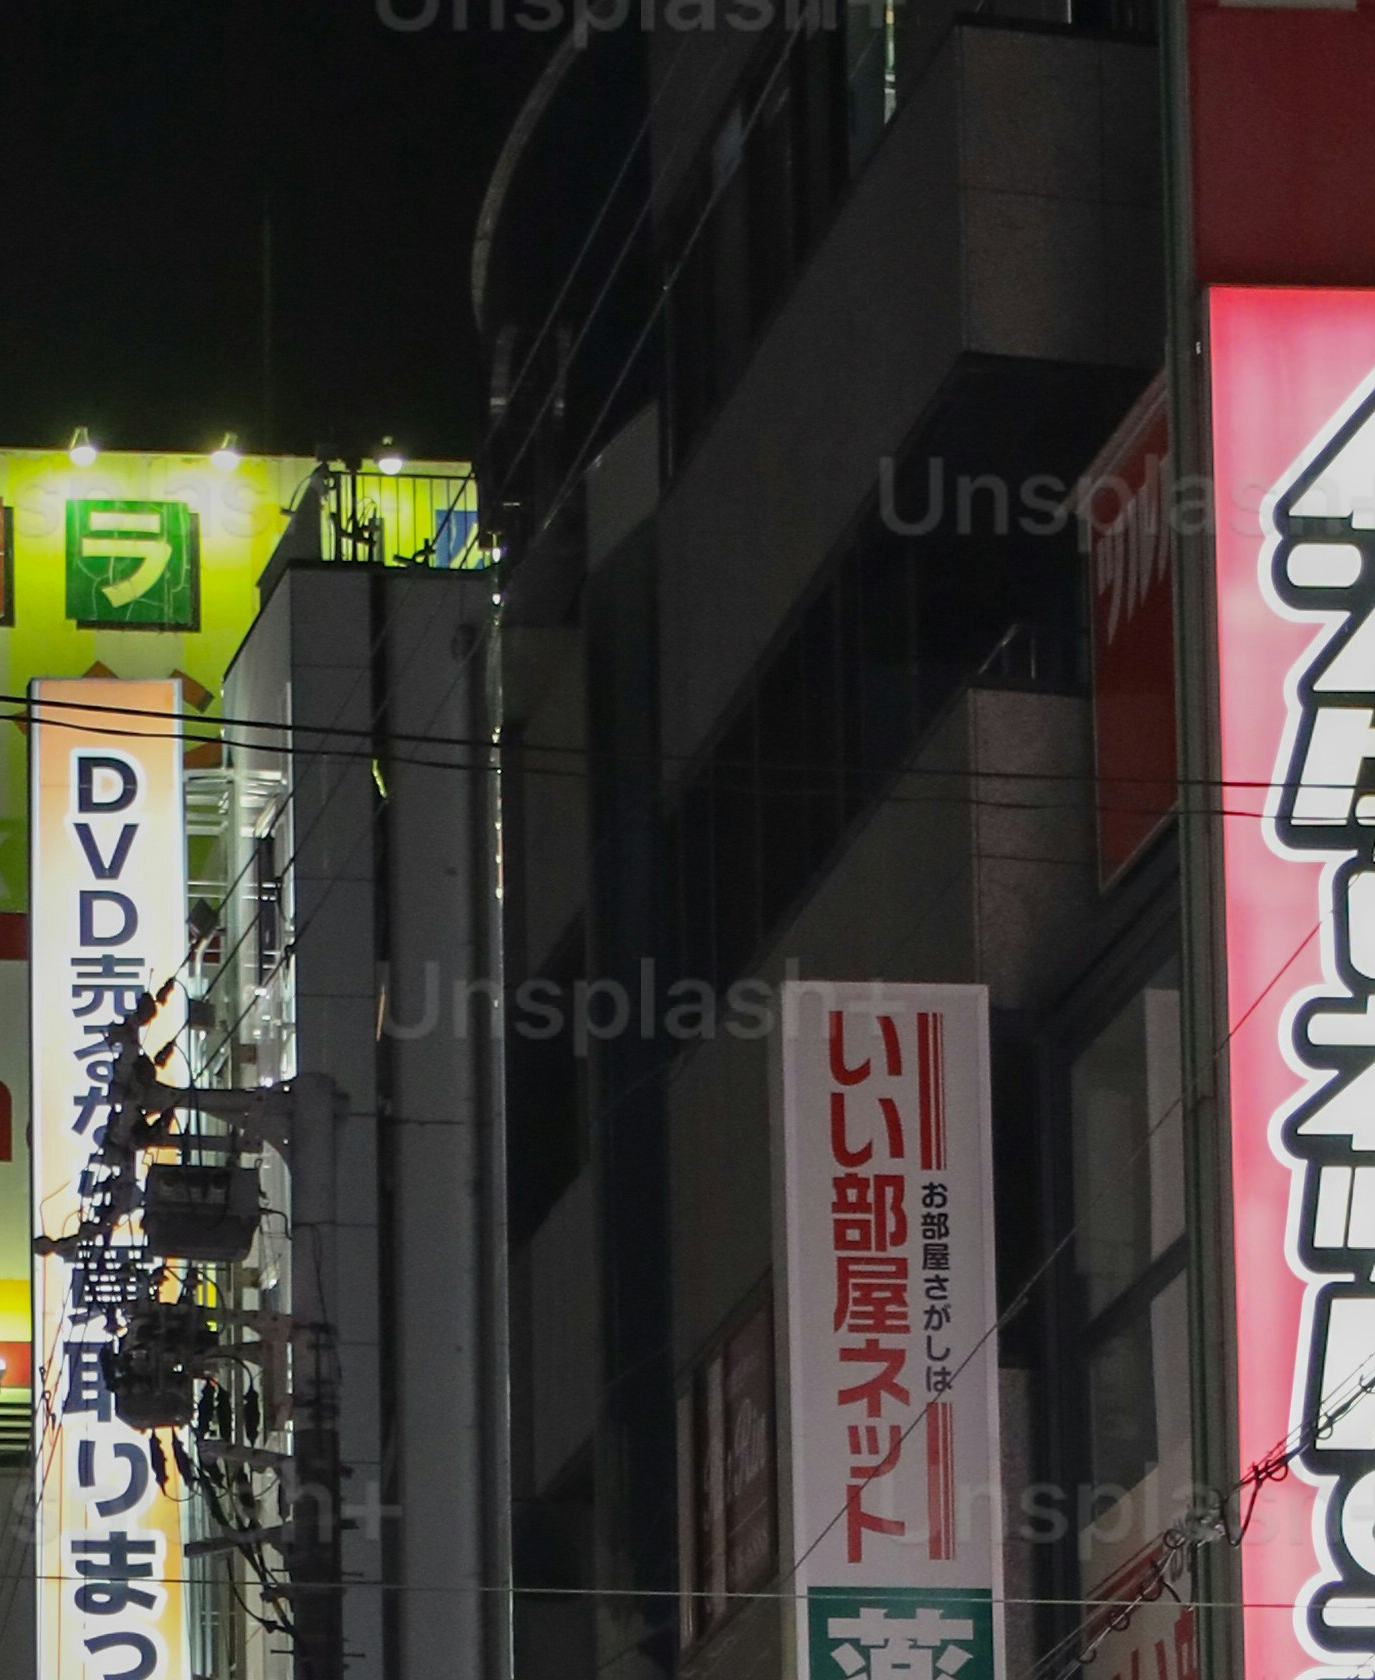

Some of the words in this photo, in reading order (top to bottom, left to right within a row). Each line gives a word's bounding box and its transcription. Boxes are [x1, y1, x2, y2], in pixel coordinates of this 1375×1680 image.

[827, 1012, 912, 1565] いい部屋ネット
[919, 1181, 954, 1393] お部屋さがしは
